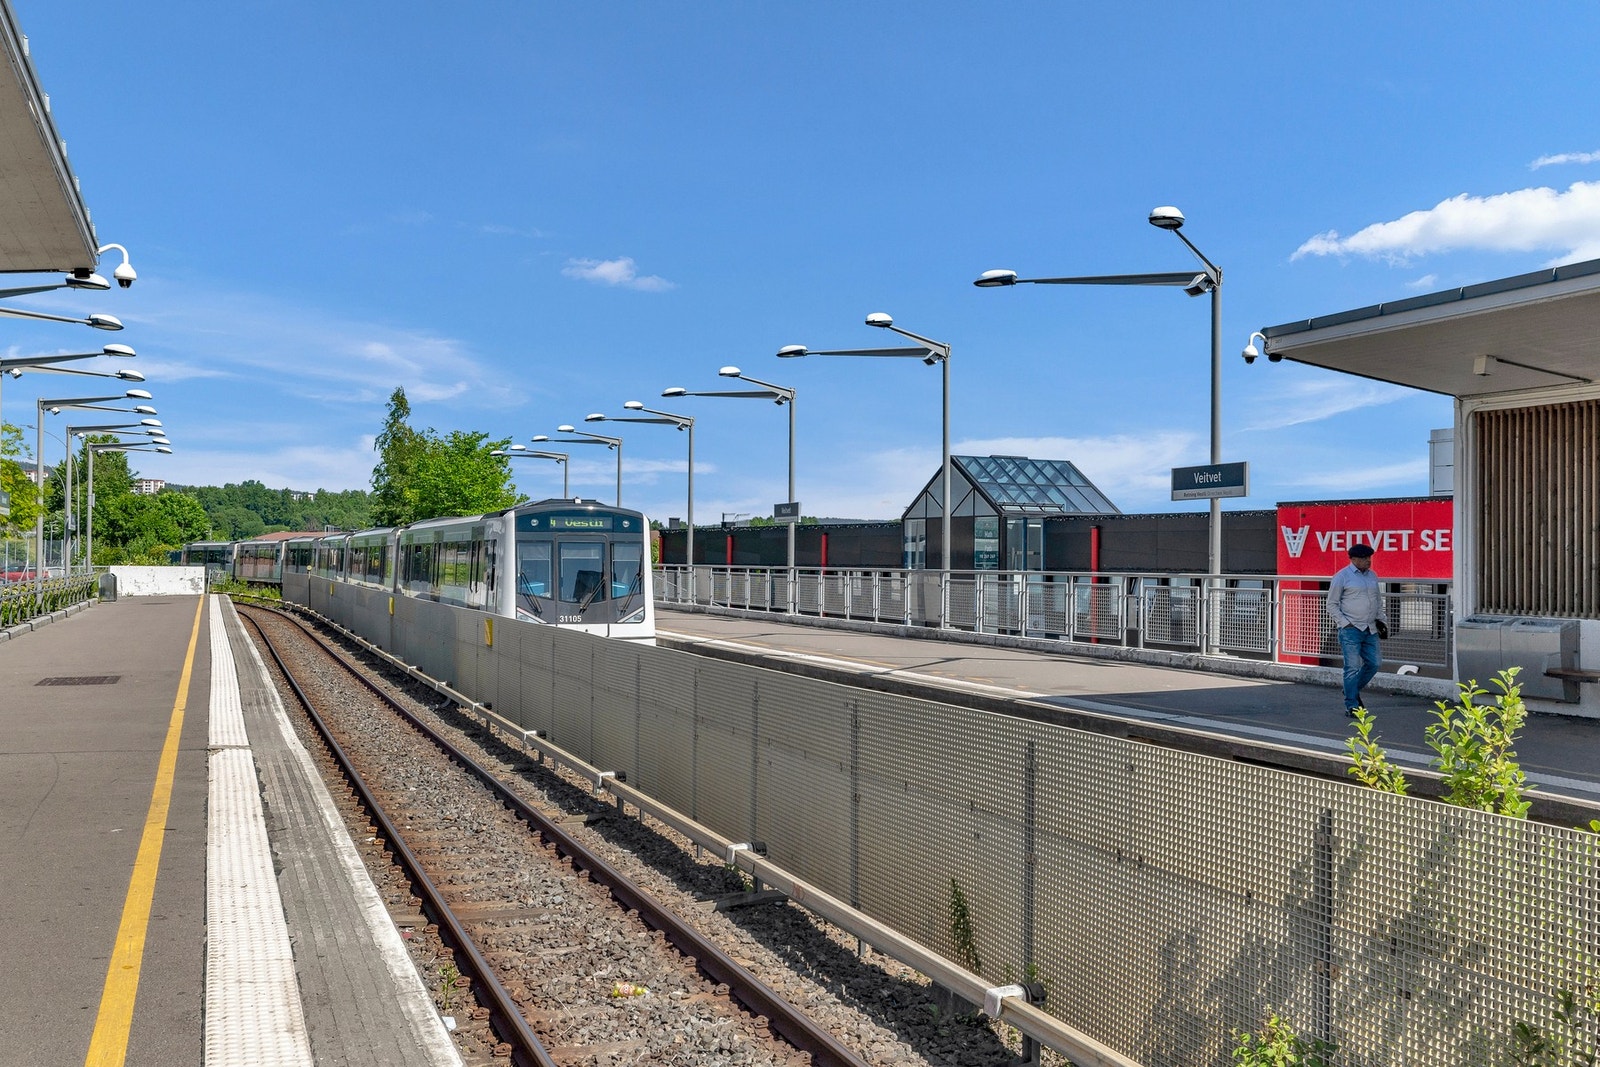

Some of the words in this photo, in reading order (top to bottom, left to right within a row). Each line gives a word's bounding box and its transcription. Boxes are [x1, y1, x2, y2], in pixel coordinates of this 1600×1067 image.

[1193, 471, 1221, 483] Veitvet
[550, 519, 556, 527] 4
[1315, 530, 1414, 552] VEITVET
[1420, 529, 1454, 551] SE
